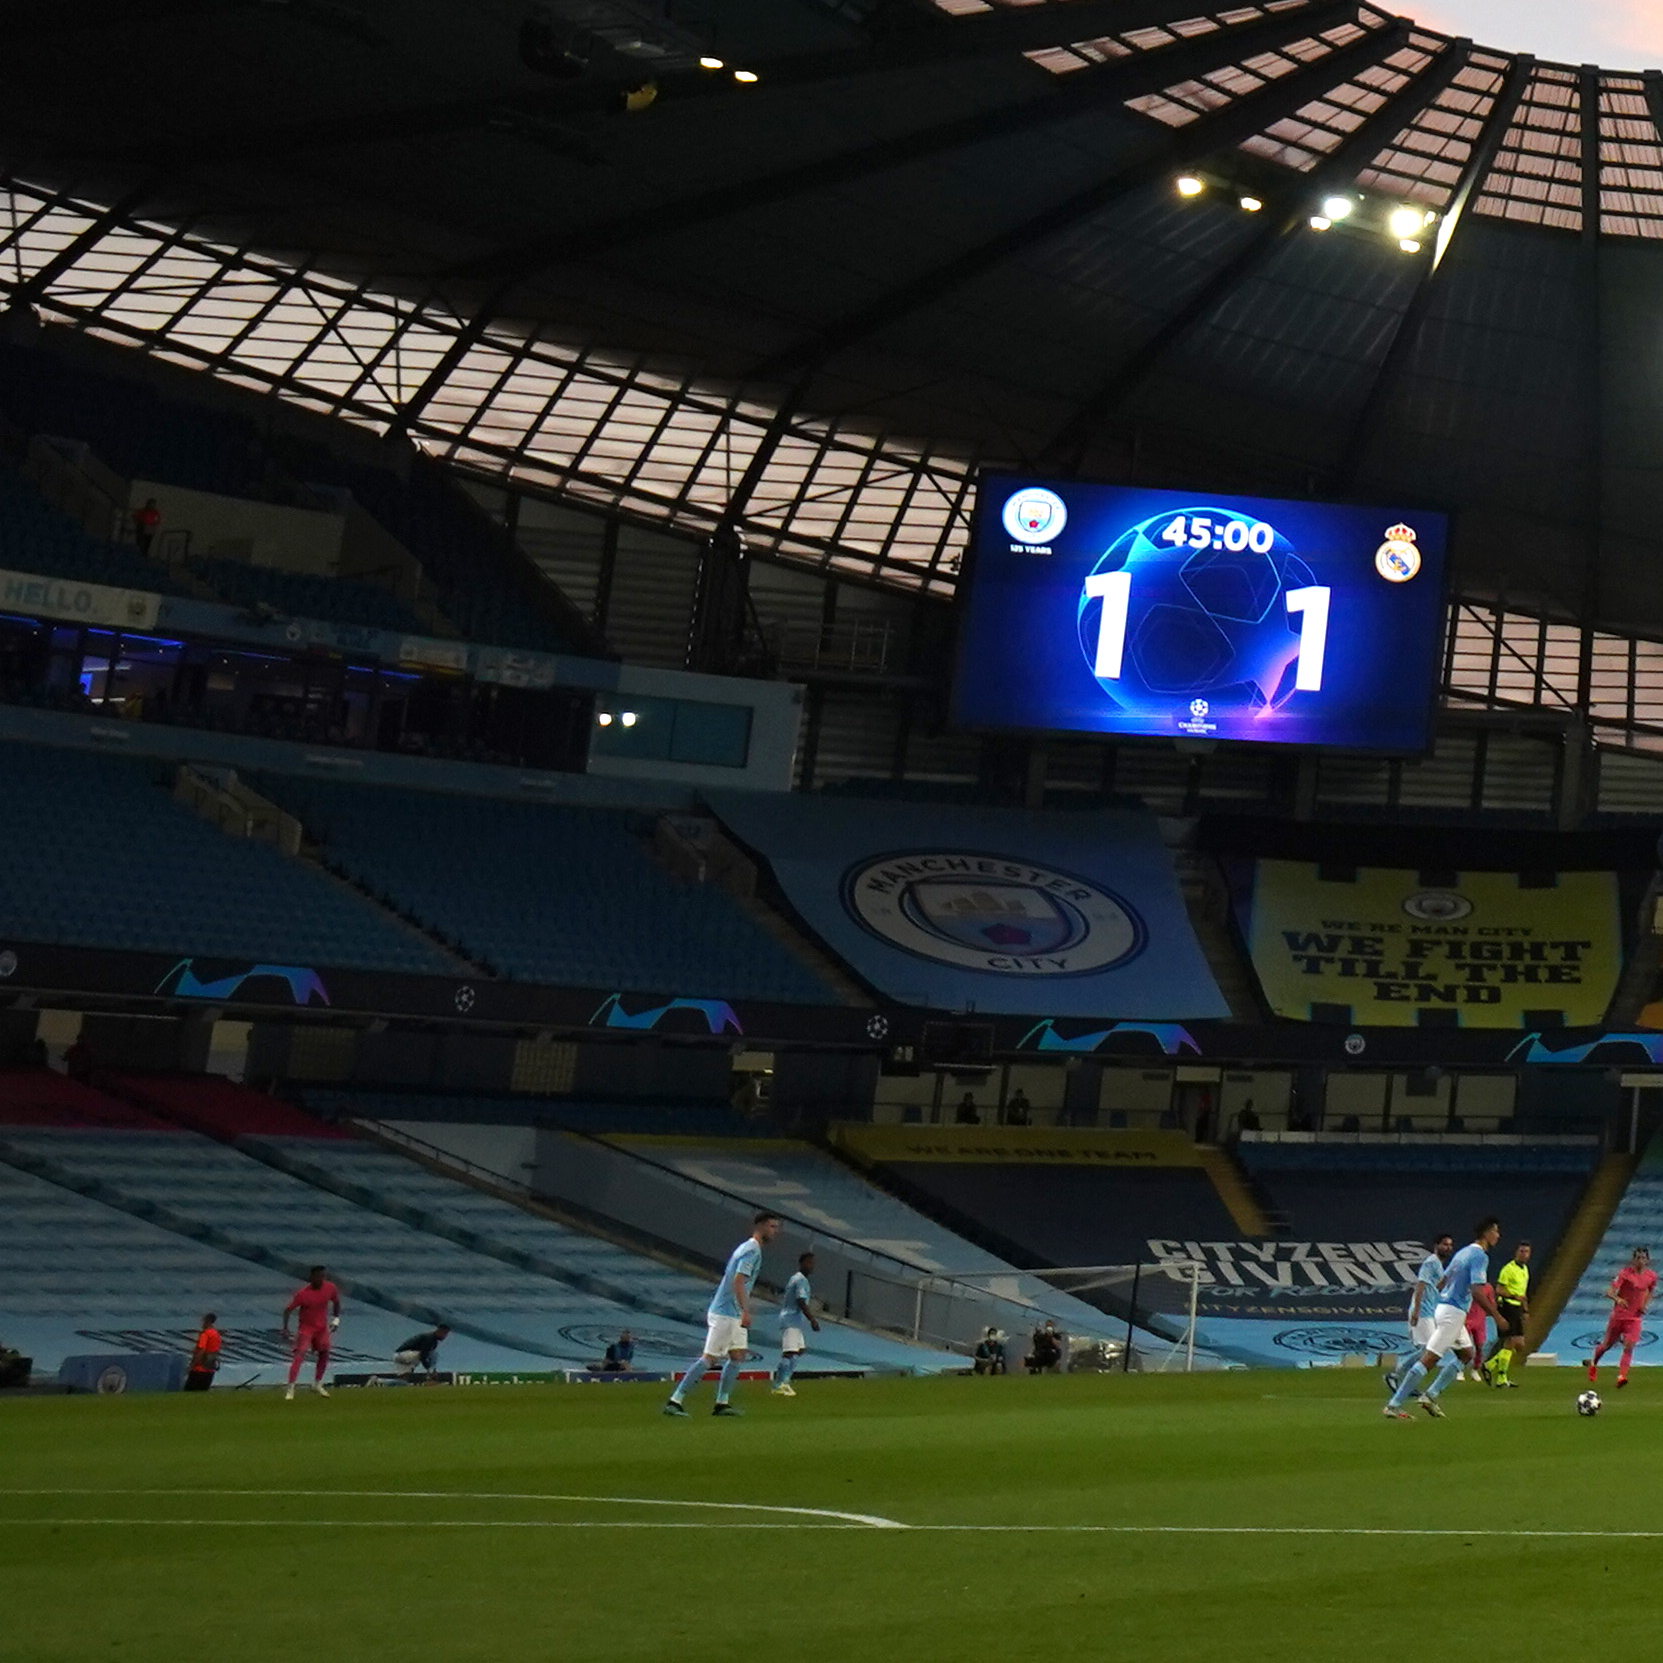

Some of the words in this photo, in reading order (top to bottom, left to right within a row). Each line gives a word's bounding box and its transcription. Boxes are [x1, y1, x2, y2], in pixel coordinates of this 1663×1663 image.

[1162, 516, 1274, 553] 45:00
[1085, 570, 1132, 679] 1
[1285, 585, 1331, 692] 1
[866, 857, 1092, 902] MANCHESTER
[1478, 926, 1533, 937] CITY
[1282, 931, 1384, 957] WE
[1405, 937, 1592, 962] FIGHT
[987, 956, 1068, 971] CITY
[1455, 962, 1582, 984] THE
[1373, 981, 1502, 1004] END
[1147, 1238, 1435, 1262] CITYZENS
